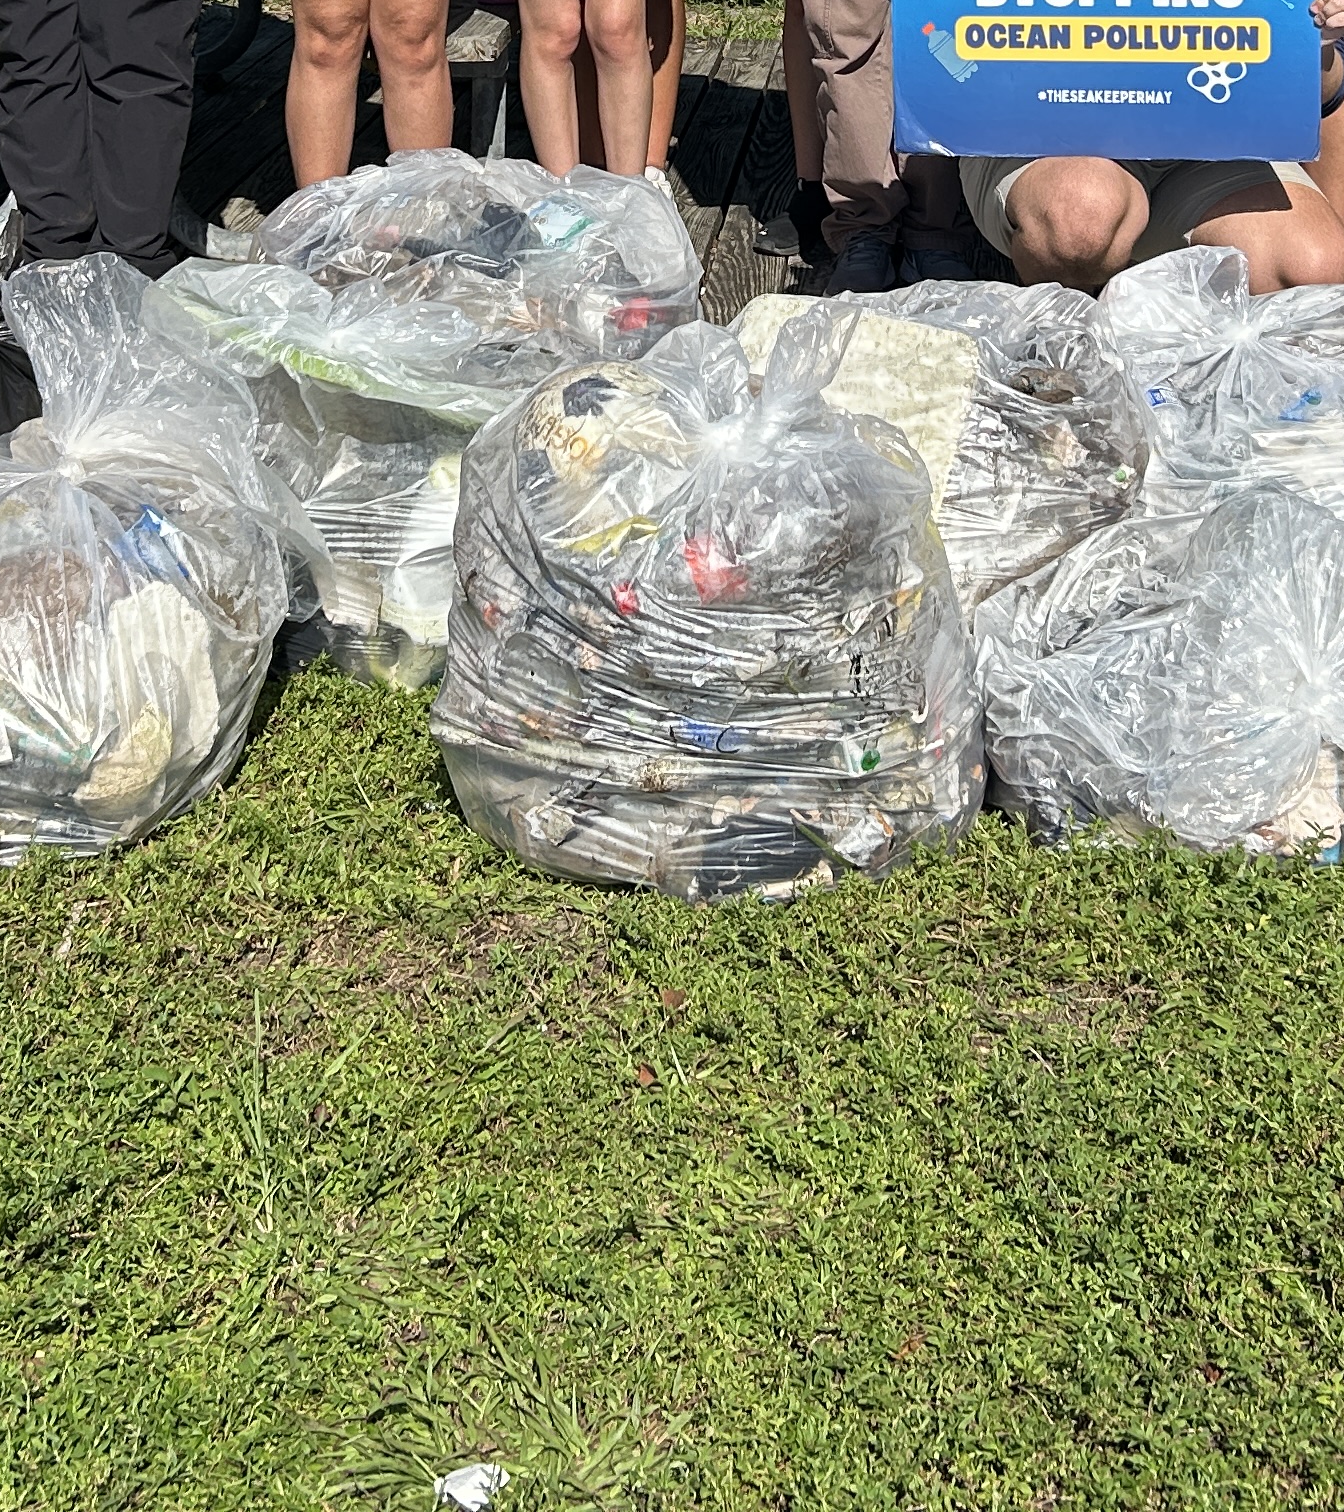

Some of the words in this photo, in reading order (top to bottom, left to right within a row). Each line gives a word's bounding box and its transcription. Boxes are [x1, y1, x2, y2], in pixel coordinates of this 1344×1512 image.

[964, 24, 1071, 50] OCEAN
[1083, 24, 1259, 52] POLLUTION
[1037, 89, 1172, 106] #THESEAKEEPERWAY
